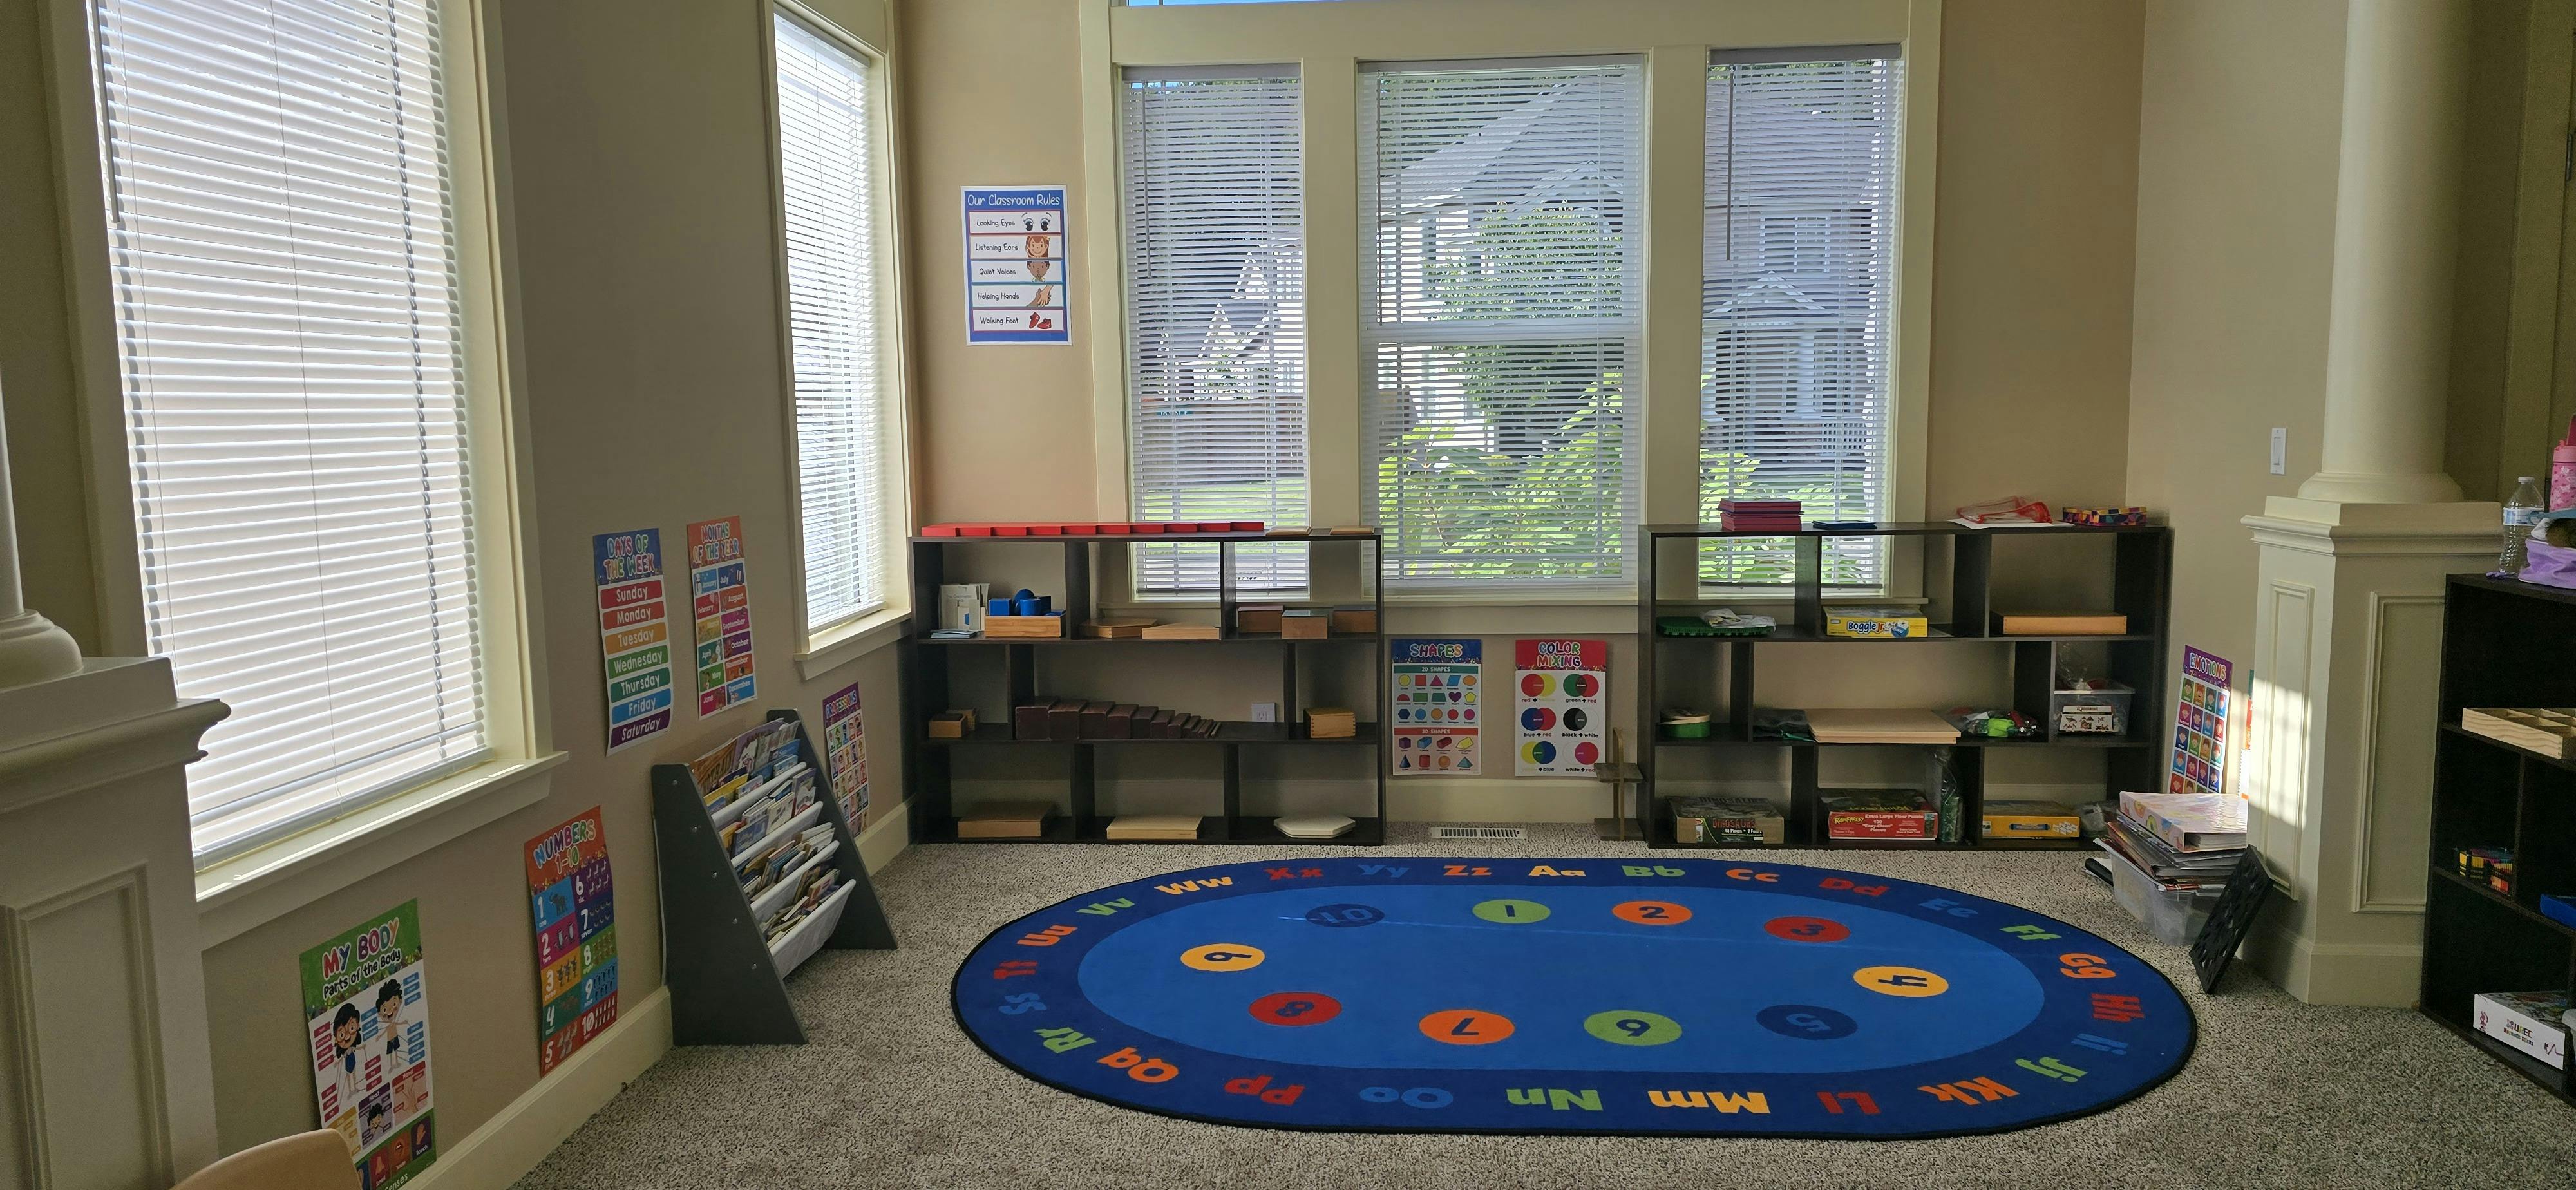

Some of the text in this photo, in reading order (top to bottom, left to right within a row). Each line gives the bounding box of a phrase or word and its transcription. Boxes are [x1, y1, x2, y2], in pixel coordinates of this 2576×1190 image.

[967, 193, 1061, 206] Our Classroom Rules
[976, 219, 1016, 227] Looking Eyes
[975, 243, 1001, 252] Listening
[977, 292, 999, 301] Helping
[980, 317, 1004, 325] Walking
[701, 521, 730, 543] MONTHS
[607, 534, 649, 558] DAYS OF
[693, 538, 739, 563] OF THE YEAR
[603, 553, 654, 580] THE WEEK
[720, 576, 729, 585] July
[616, 586, 649, 602] Sunday
[617, 607, 651, 625] Monday
[698, 605, 714, 614] February
[723, 618, 746, 630] September
[1848, 621, 1876, 633] Boggle
[1877, 622, 1885, 632] Jr.
[618, 629, 654, 647] Tuesday
[731, 638, 749, 649] October
[1409, 643, 1463, 657] SHAPES
[1538, 641, 1581, 655] COLOR
[614, 651, 663, 674] Wednesday
[1537, 654, 1582, 668] MIXING
[2190, 652, 2227, 681] EMOTIONS
[712, 670, 722, 679] May
[621, 674, 660, 695] Thursday
[629, 697, 656, 716] Friday
[621, 718, 661, 741] Saturday
[1712, 818, 1756, 829] DINOSAURS
[533, 818, 596, 869] NUMBERS
[555, 845, 580, 874] 1-10
[1267, 867, 1322, 880] Xx
[1357, 865, 1409, 878] Yy
[1444, 865, 1490, 876] Zz
[1530, 865, 1584, 876] Aa
[1623, 865, 1684, 876] Bb
[1726, 868, 1777, 882] Cc
[576, 875, 583, 896] 6
[1155, 876, 1233, 895] Ww
[1820, 878, 1889, 896] Dd
[537, 896, 544, 919] 1
[1079, 898, 1133, 915] Vv
[1505, 905, 1515, 917] 1
[1639, 906, 1668, 918] 2
[1918, 898, 1979, 918] Ee
[580, 909, 589, 930] 7
[1321, 909, 1373, 923] 10
[1018, 925, 1076, 947] Uu
[1793, 923, 1824, 936] 3
[2000, 925, 2061, 940] Ff
[323, 917, 400, 980] MY BODY
[541, 932, 551, 956] 2
[583, 945, 592, 965] 8
[1204, 952, 1252, 962] 9
[323, 948, 402, 1001] Parts of the Body
[994, 961, 1037, 979] Tt
[2060, 952, 2116, 979] Gg
[545, 969, 554, 992] 3
[585, 978, 593, 1000] 9
[1878, 973, 1927, 987] 4
[998, 992, 1047, 1014] Ss
[1276, 1001, 1314, 1017] 8
[2092, 994, 2144, 1022] Hh
[547, 1005, 555, 1026] 4
[582, 1012, 594, 1035] 10
[1786, 1014, 1832, 1032] 5
[1452, 1018, 1479, 1035] 7
[1035, 1027, 1095, 1053] Rr
[545, 1041, 554, 1063] 5
[1098, 1046, 1179, 1083] Qq
[2016, 1057, 2087, 1082] Jj
[402, 1069, 413, 1079] Hand
[368, 1091, 379, 1101] Head
[1224, 1075, 1305, 1105] Pp
[1359, 1087, 1454, 1108] Oo
[1917, 1075, 2019, 1106] Kk
[1506, 1088, 1602, 1111] Nn
[1648, 1090, 1770, 1114] Mm
[416, 1145, 428, 1155] Touch
